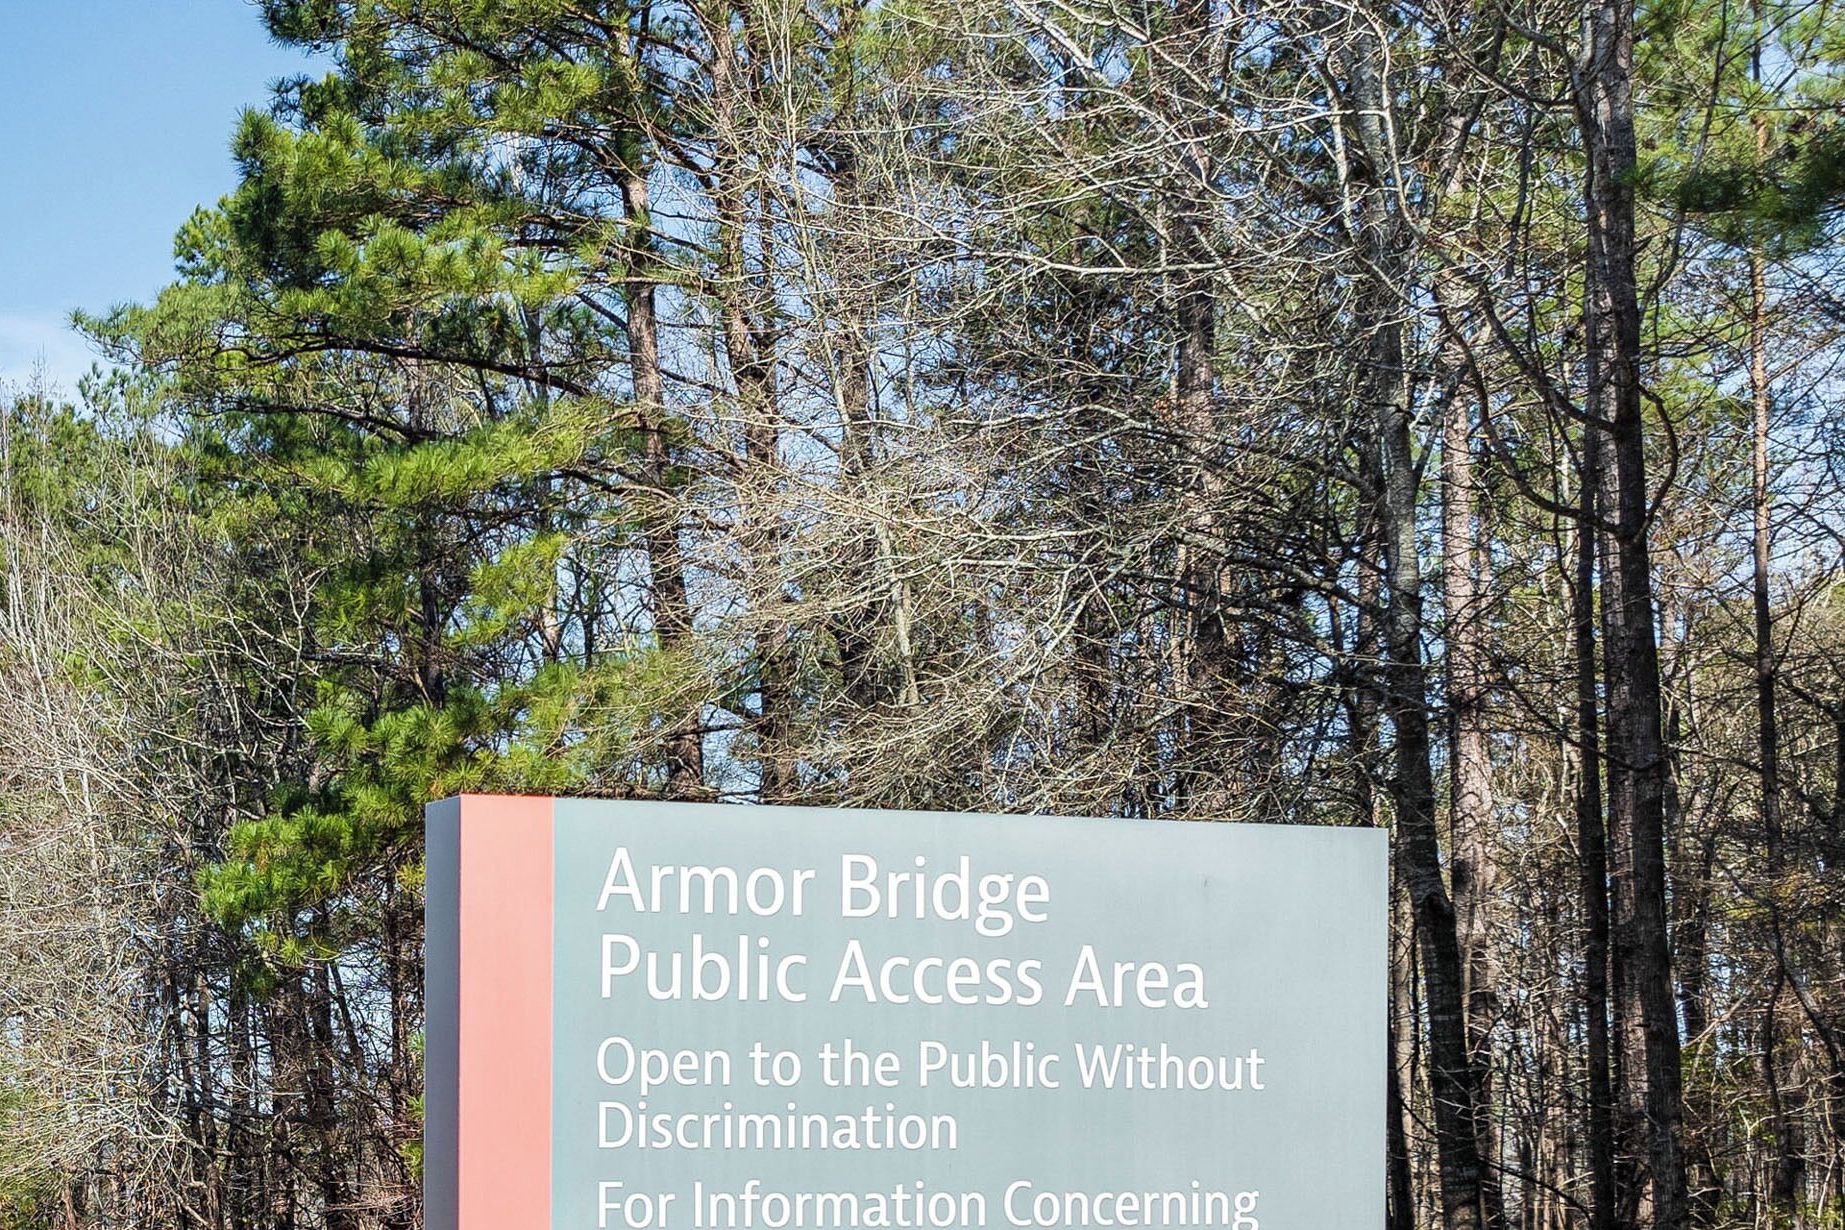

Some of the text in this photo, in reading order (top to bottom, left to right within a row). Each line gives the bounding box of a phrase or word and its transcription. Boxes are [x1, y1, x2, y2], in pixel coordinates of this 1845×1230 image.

[596, 847, 1050, 937] Armor Bridge
[601, 933, 1209, 1009] Public Access Area
[596, 1036, 1265, 1096] Open to the Public Without
[598, 1101, 957, 1149] Discrimination
[598, 1181, 676, 1229] For
[694, 1179, 986, 1228] Information
